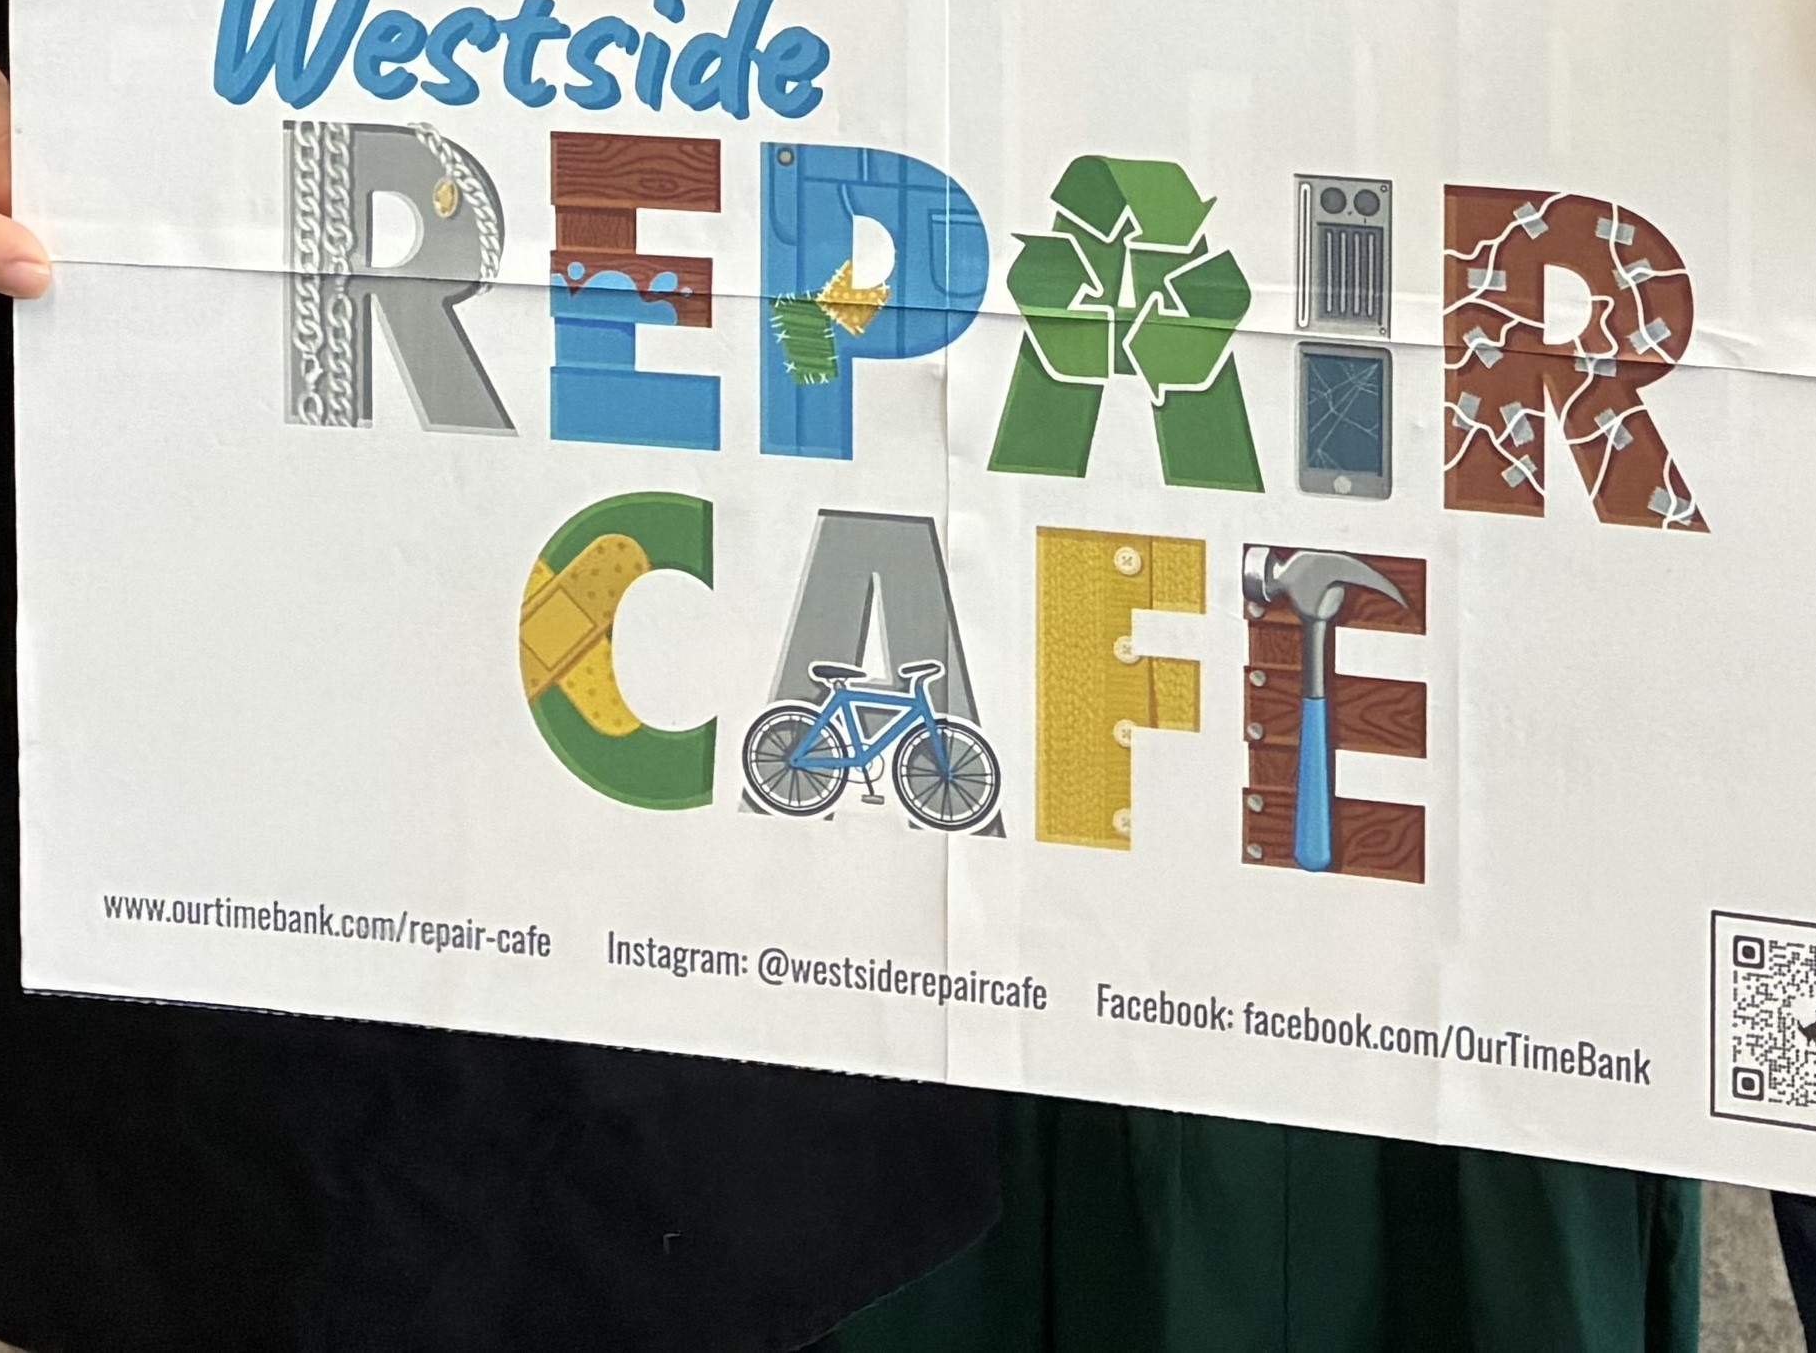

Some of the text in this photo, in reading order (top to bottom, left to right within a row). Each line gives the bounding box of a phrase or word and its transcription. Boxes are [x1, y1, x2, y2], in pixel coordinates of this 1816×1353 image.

[283, 119, 1711, 534] REPAIR
[518, 491, 1428, 885] CAFE
[102, 894, 1652, 1087] www.ourtimebank.com/repair-cafe Instagram: @westsiderepaircafe Facebook: facebook.com/OurTimeBank
